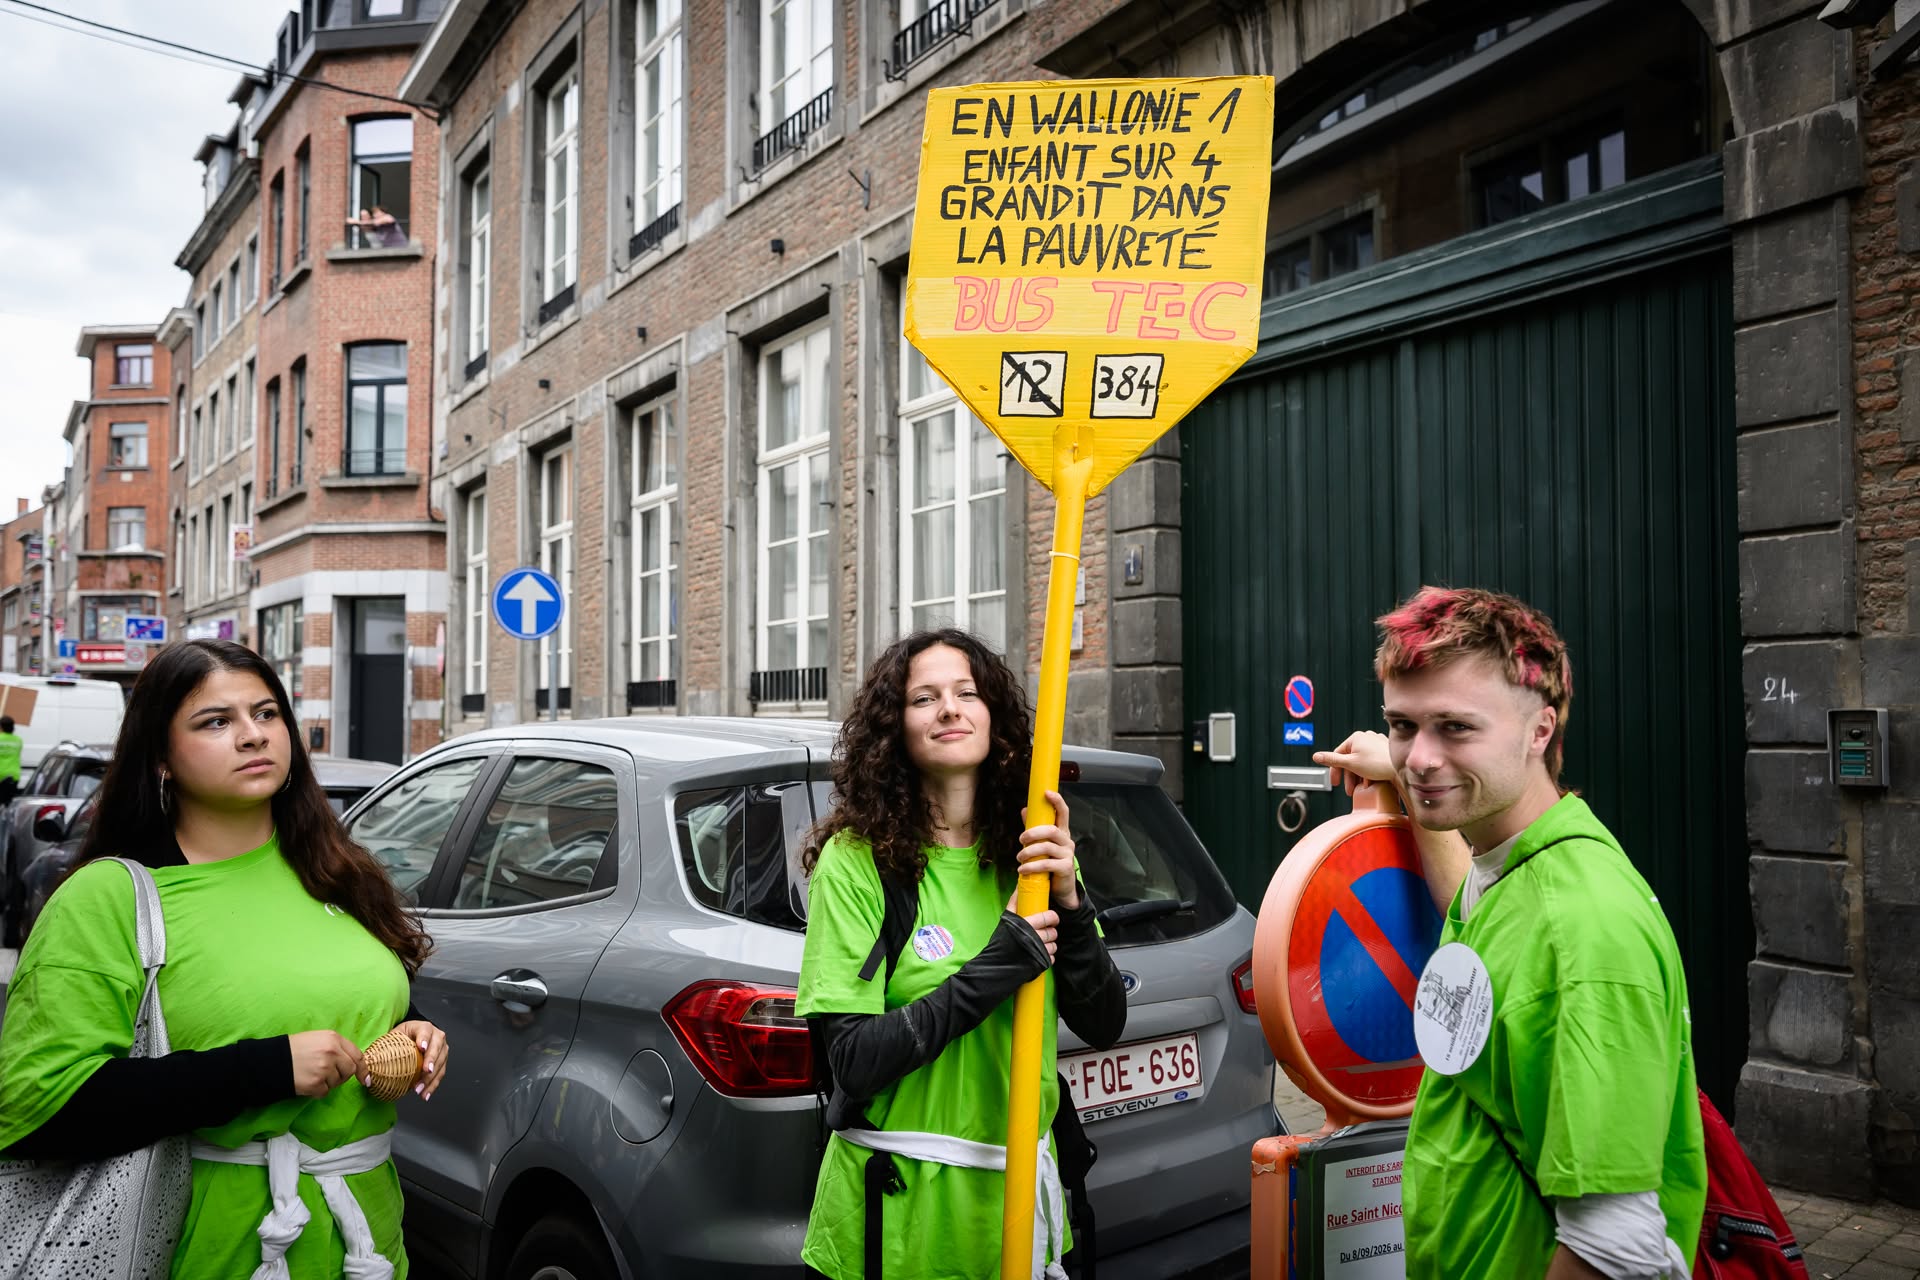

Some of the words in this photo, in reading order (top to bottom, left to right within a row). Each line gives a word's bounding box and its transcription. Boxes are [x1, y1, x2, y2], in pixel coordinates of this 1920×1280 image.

[952, 95, 1015, 138] EN
[1208, 88, 1242, 134] 1
[963, 141, 1097, 184] ENFANT
[1102, 142, 1176, 180] SUR
[1191, 140, 1222, 183] 4
[1129, 183, 1231, 221] DANS
[957, 225, 1006, 265] LA
[1021, 221, 1219, 272] PAUVRETÉ
[954, 276, 1058, 332] BUS
[1092, 281, 1247, 340] TEC
[1098, 365, 1155, 406] 384
[1760, 677, 1799, 704] 24
[1083, 1097, 1159, 1122] STEVENY
[1377, 1164, 1386, 1172] DE
[1327, 1213, 1349, 1228] Rue
[1351, 1206, 1379, 1223] Saint
[1340, 1252, 1351, 1262] Du
[1352, 1242, 1392, 1260] 8/09/2026
[1393, 1242, 1403, 1251] au
